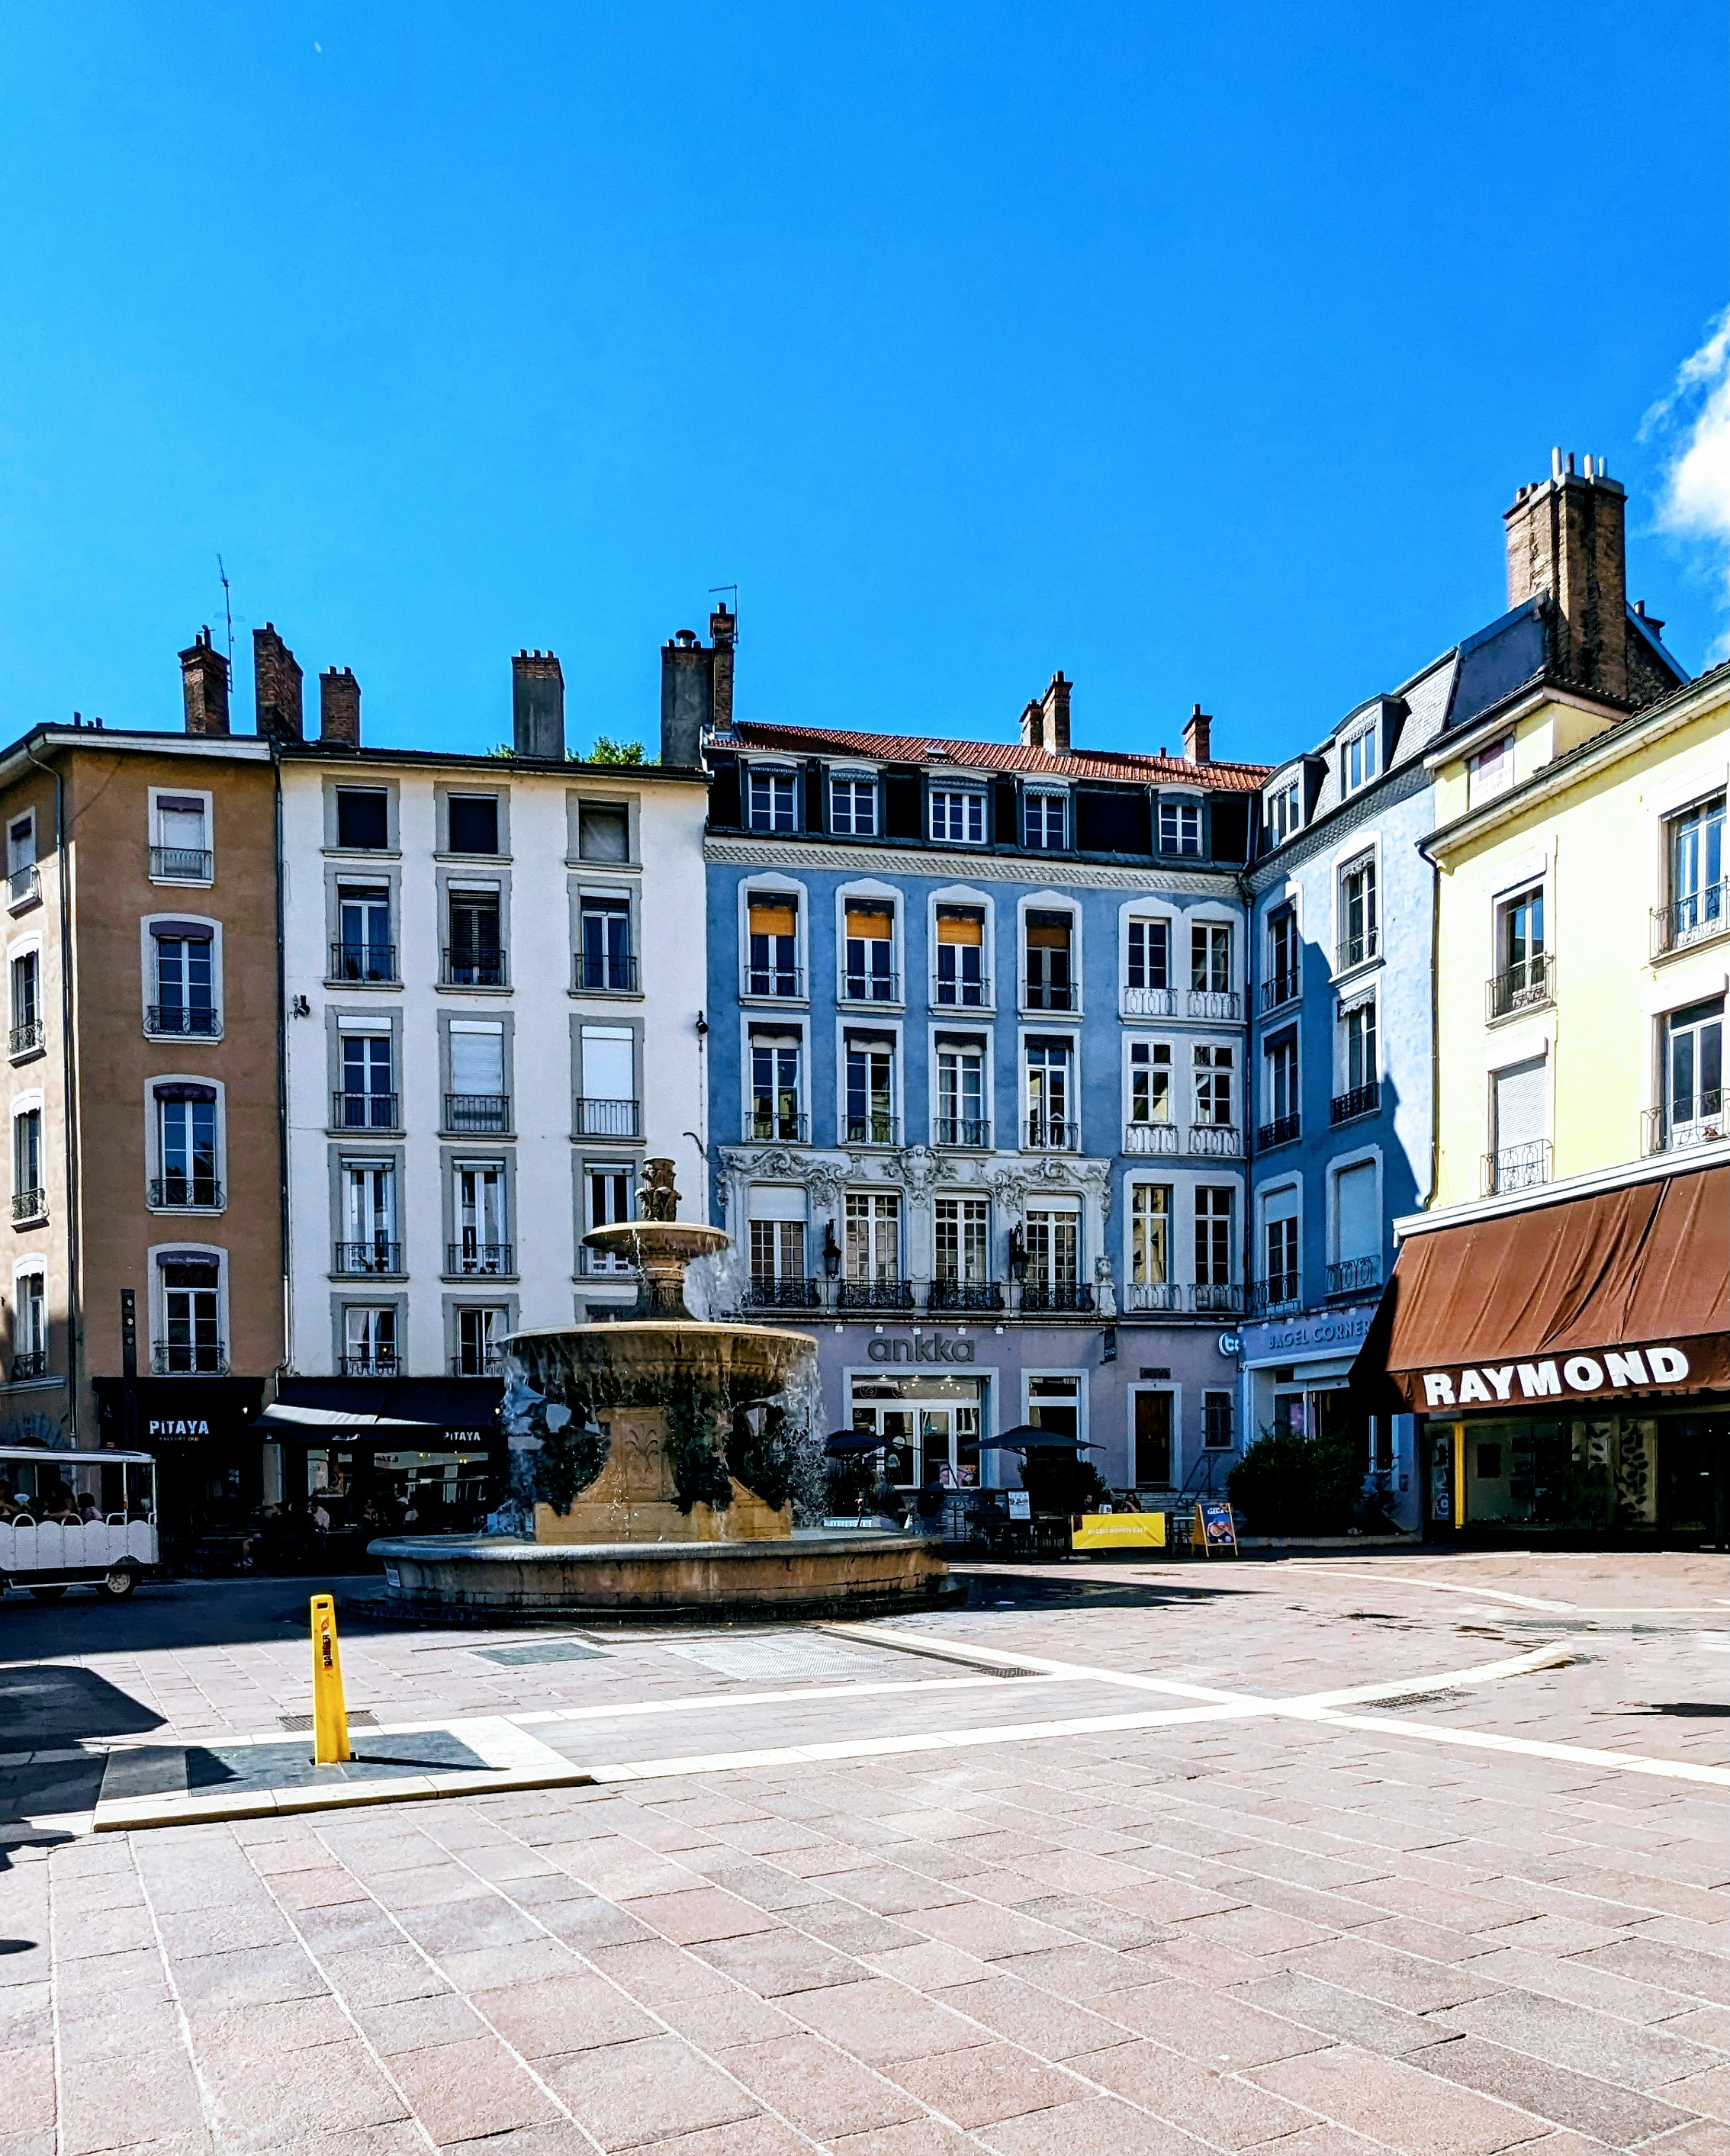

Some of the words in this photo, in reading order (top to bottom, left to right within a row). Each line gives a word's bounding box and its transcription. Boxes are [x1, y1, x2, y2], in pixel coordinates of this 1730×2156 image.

[868, 1332, 975, 1362] ankka
[1269, 1329, 1310, 1349] BAGEL
[1423, 1347, 1690, 1406] RAYMOND
[322, 1634, 333, 1667] DANGER
